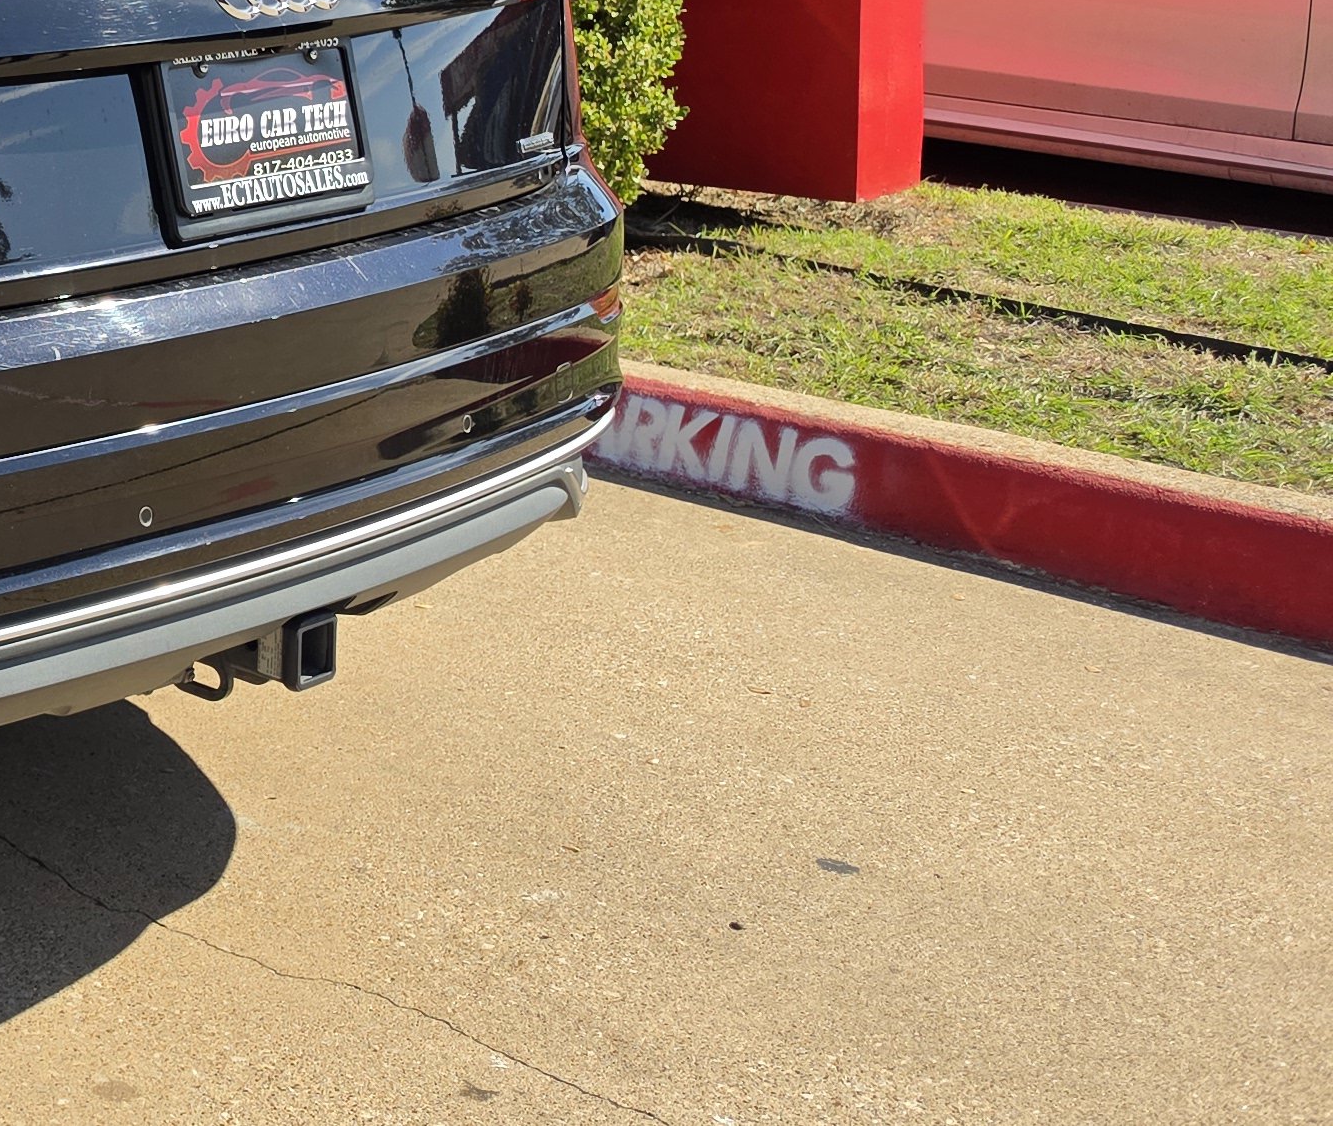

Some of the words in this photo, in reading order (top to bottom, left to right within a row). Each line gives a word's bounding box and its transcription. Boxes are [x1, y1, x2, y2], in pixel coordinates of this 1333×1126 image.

[201, 113, 254, 148] EURO
[260, 107, 298, 139] CAR
[302, 100, 348, 133] TECH
[250, 135, 297, 152] european
[298, 127, 351, 146] automotive
[253, 148, 353, 176] 817-404-4033
[192, 165, 369, 214] www.ECTAUTOSALES.com
